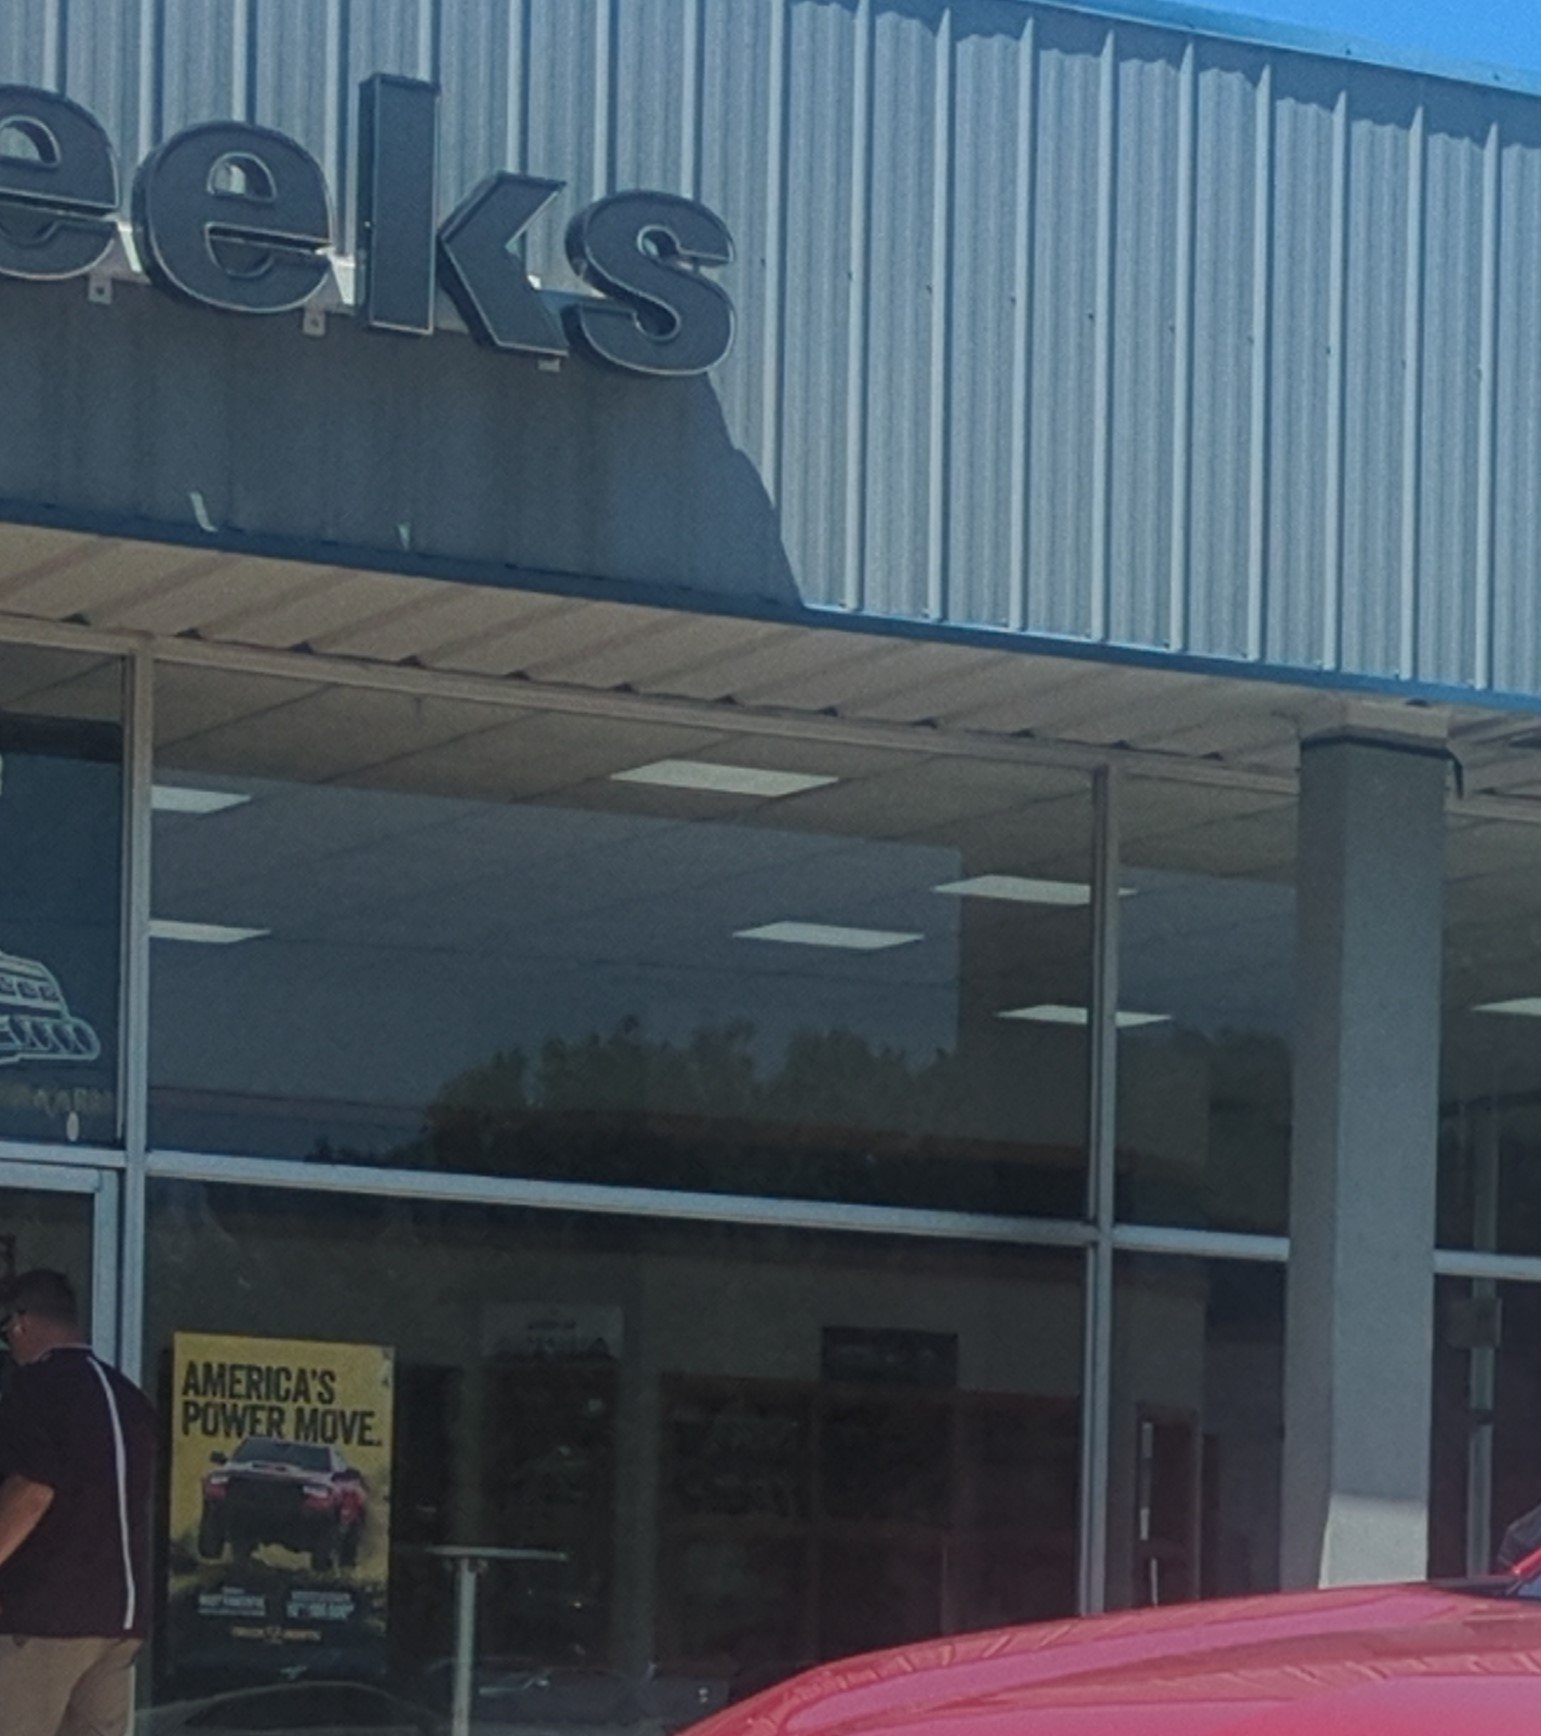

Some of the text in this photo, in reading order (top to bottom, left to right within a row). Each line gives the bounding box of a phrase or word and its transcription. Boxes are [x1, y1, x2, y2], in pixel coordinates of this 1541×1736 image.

[182, 1360, 336, 1405] AMERICA'S
[182, 1401, 384, 1447] POWER MOVE.
